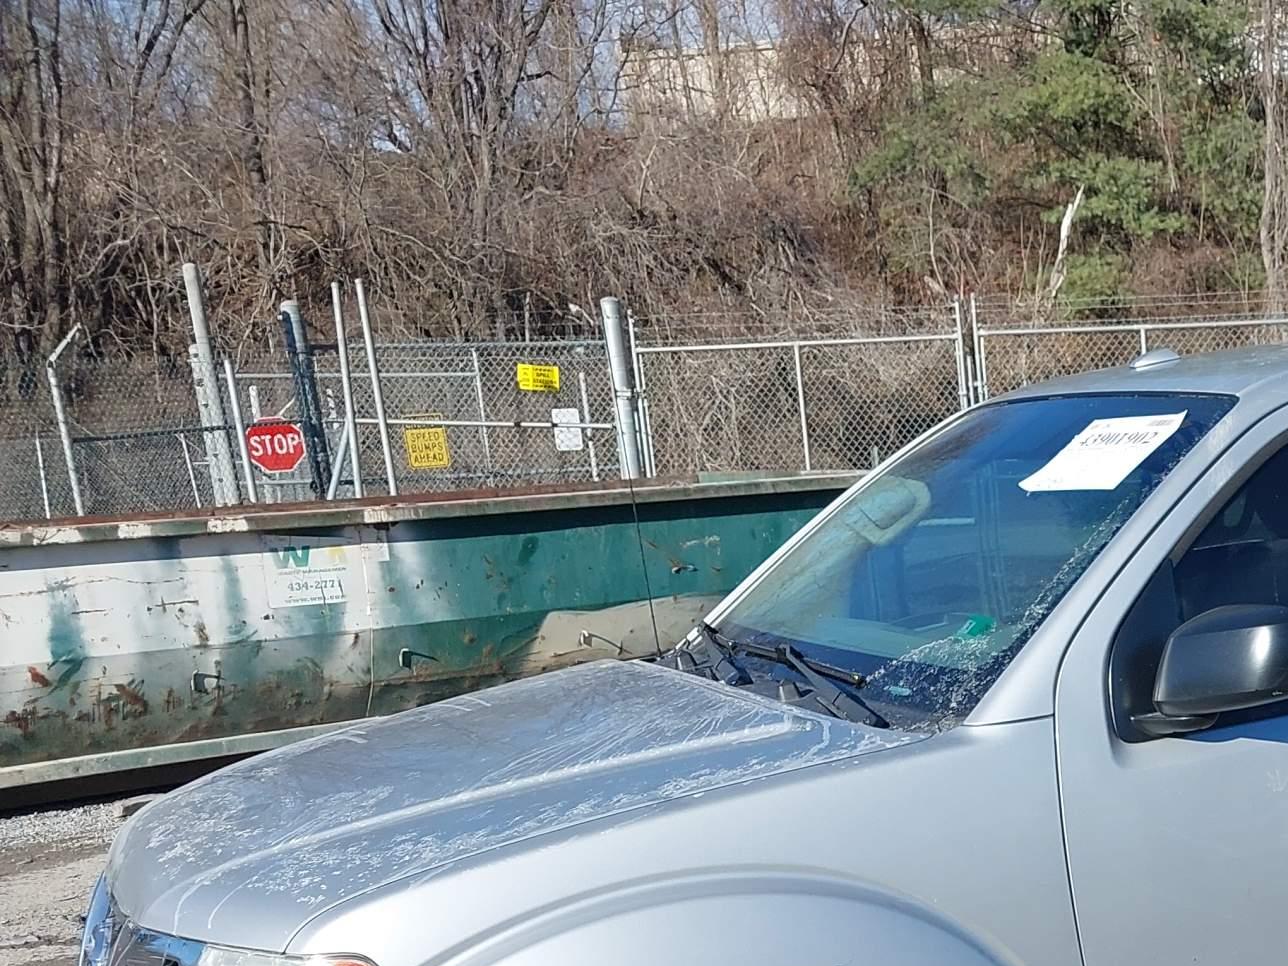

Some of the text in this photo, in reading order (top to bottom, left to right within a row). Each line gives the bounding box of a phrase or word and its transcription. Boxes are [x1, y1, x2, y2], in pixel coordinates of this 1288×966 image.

[410, 431, 440, 442] SPEED
[249, 433, 299, 457] STOP
[411, 441, 443, 453] BUMPS
[414, 453, 444, 464] AHEAD
